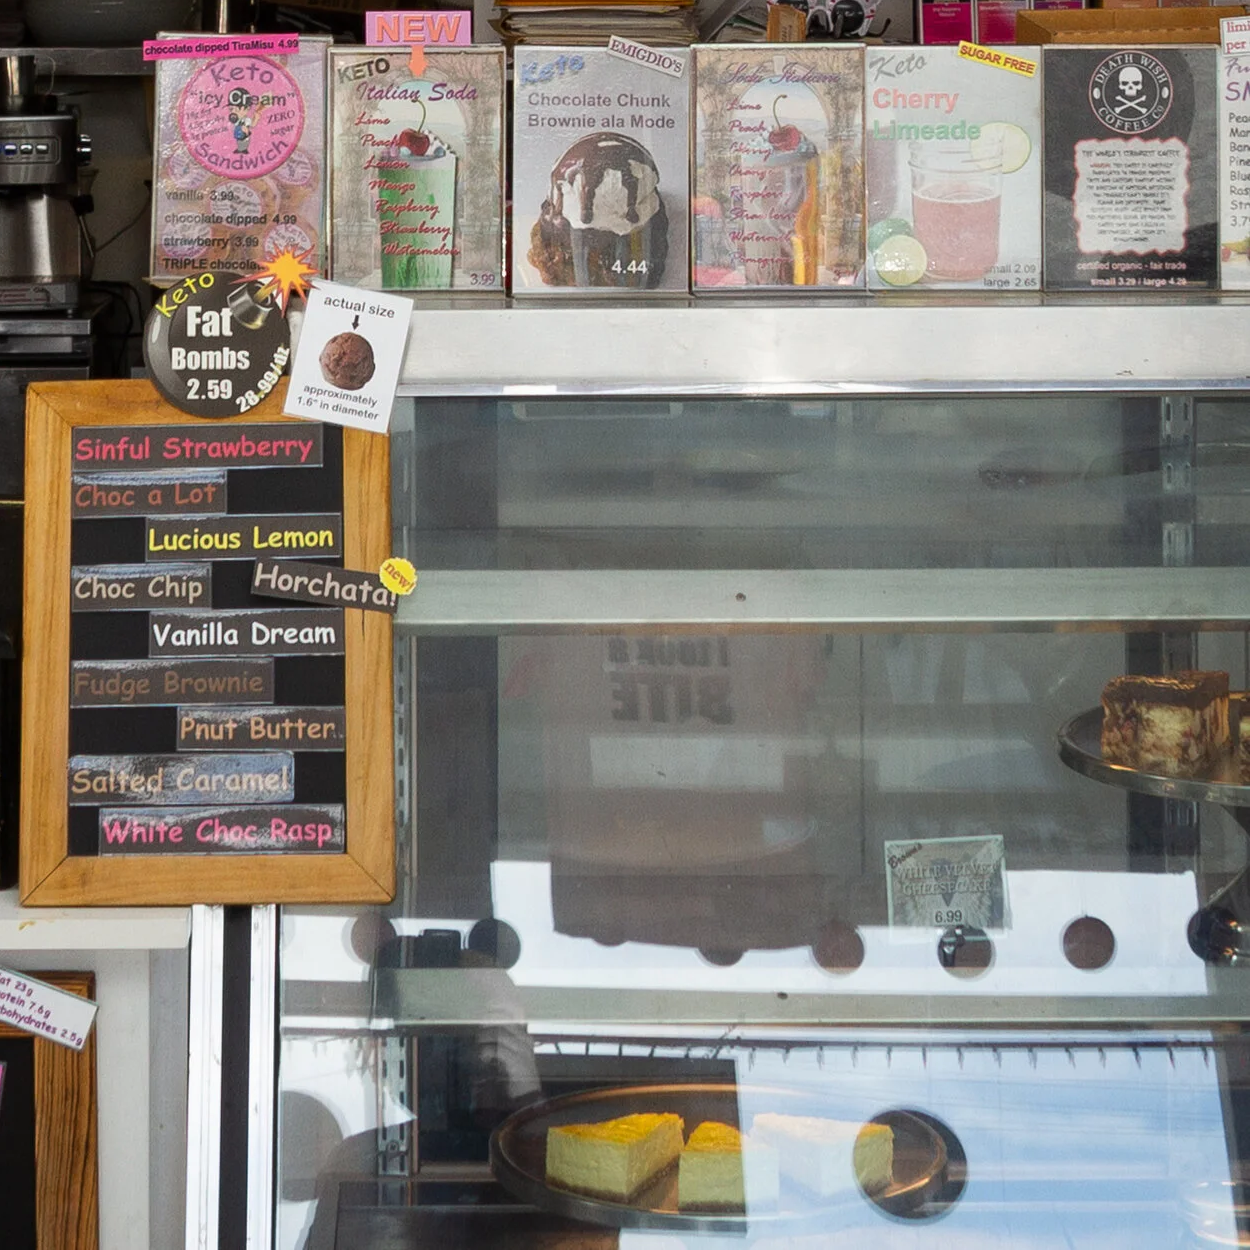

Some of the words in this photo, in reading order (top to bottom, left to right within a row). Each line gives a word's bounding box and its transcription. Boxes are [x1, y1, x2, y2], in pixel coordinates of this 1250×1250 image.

[375, 14, 461, 42] NEW
[145, 42, 193, 55] chocolate
[195, 40, 230, 53] dipped
[232, 40, 273, 51] TiraMisu
[278, 39, 299, 49] 4.99
[337, 57, 390, 84] KETO
[960, 44, 1002, 66] SUGAR
[1004, 58, 1035, 74] FREE
[356, 82, 420, 104] Italian
[428, 81, 478, 102] Soda
[528, 93, 612, 108] Chocolate
[617, 92, 671, 108] Chunk
[873, 88, 959, 114] Cherry
[528, 114, 596, 129] Brownie
[601, 114, 625, 129] ala
[630, 115, 675, 129] Mode
[873, 119, 981, 141] Limeade
[611, 259, 648, 274] 4.44
[324, 295, 365, 312] actual
[368, 302, 395, 318] size
[186, 306, 233, 337] Fat
[171, 347, 250, 370] Bombs
[187, 379, 233, 399] 2.59
[76, 437, 150, 461] Sinful
[163, 436, 313, 463] Strawberry
[76, 486, 135, 507] Choc
[149, 490, 162, 505] a
[175, 485, 215, 505] Lot
[149, 529, 241, 551] Lucious
[253, 527, 334, 548] Lemon
[75, 577, 135, 600] Choc
[148, 575, 203, 602] Chip
[254, 564, 397, 607] Horchata!
[153, 622, 238, 646] Vanilla
[252, 621, 336, 645] Dream
[75, 673, 150, 701] Fudge
[164, 671, 263, 695] Brownie
[181, 718, 237, 740] Pnut
[250, 716, 335, 739] Butter
[72, 769, 163, 794] Salted
[177, 768, 290, 792] Caramel
[103, 818, 182, 844] White
[196, 819, 257, 843] Choc
[270, 818, 332, 846] Rasp
[935, 910, 963, 923] 6.99
[14, 981, 33, 997] 23g
[29, 1001, 51, 1019] 7.6g
[60, 1029, 83, 1046] 2.5g
